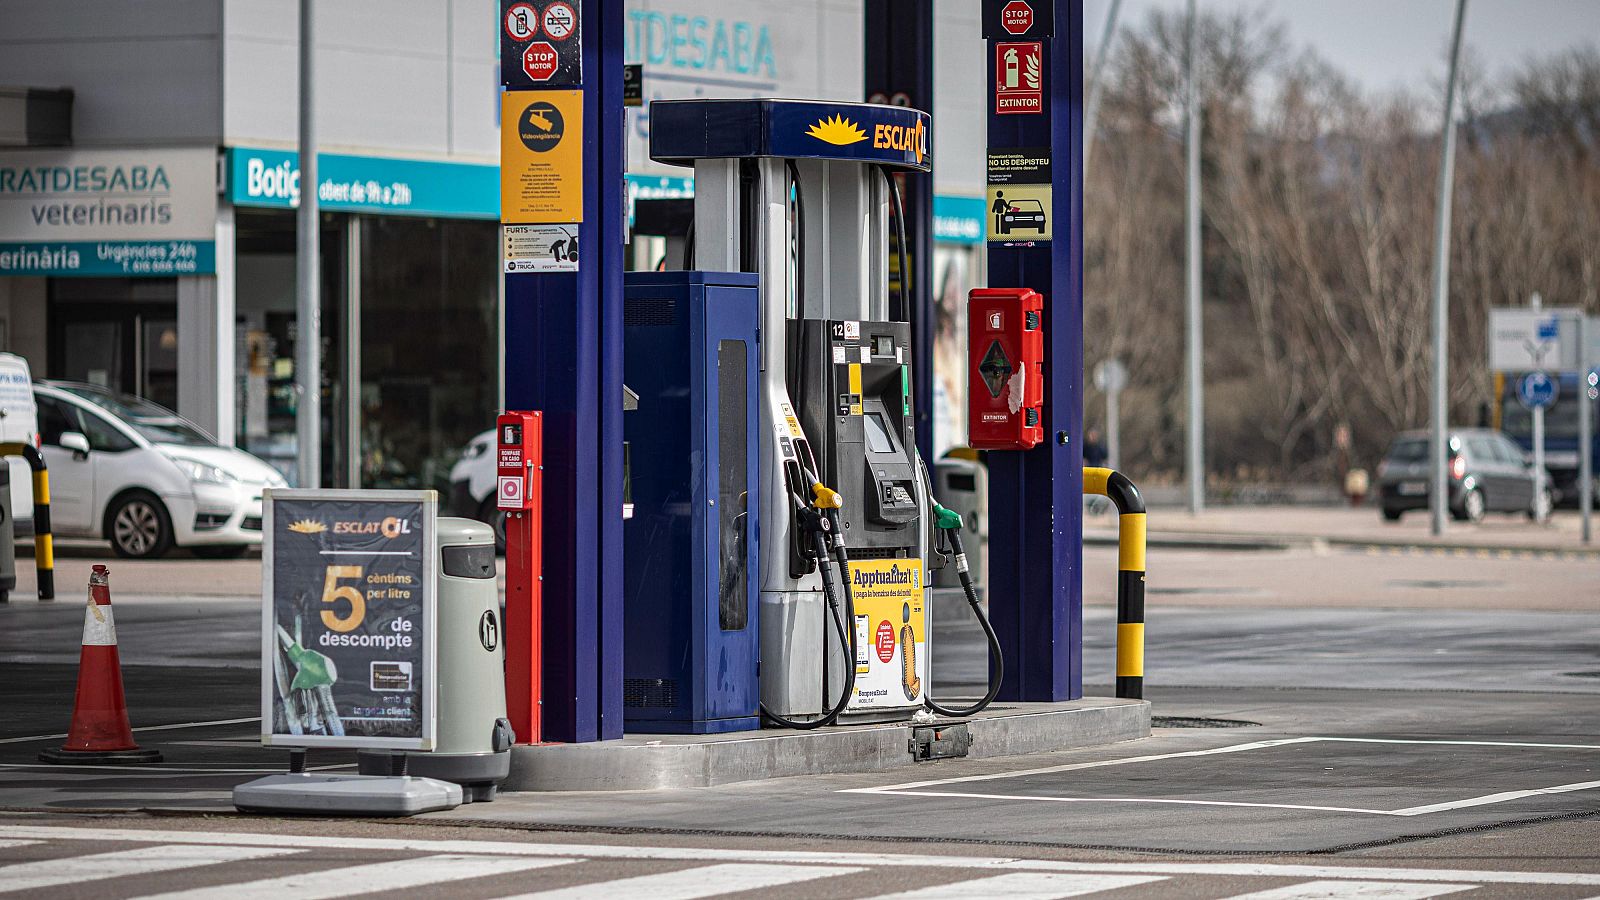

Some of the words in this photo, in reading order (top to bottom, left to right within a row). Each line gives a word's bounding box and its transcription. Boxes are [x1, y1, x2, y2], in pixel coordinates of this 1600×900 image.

[624, 9, 777, 77] TDESABA
[527, 53, 554, 61] STOP
[1000, 98, 1038, 107] EXTINTOR
[0, 165, 170, 192] RATDESABA
[248, 158, 300, 208] Botig
[31, 199, 172, 226] veterinaris
[97, 244, 166, 262] Urgències
[833, 324, 844, 336] 12
[366, 572, 412, 584] cèntims
[320, 565, 366, 632] 5
[367, 590, 386, 600] per
[388, 588, 410, 599] litre
[856, 591, 867, 599] paga
[390, 617, 412, 632] de
[319, 631, 413, 650] descompte
[878, 632, 883, 648] 7
[386, 706, 411, 715] client
